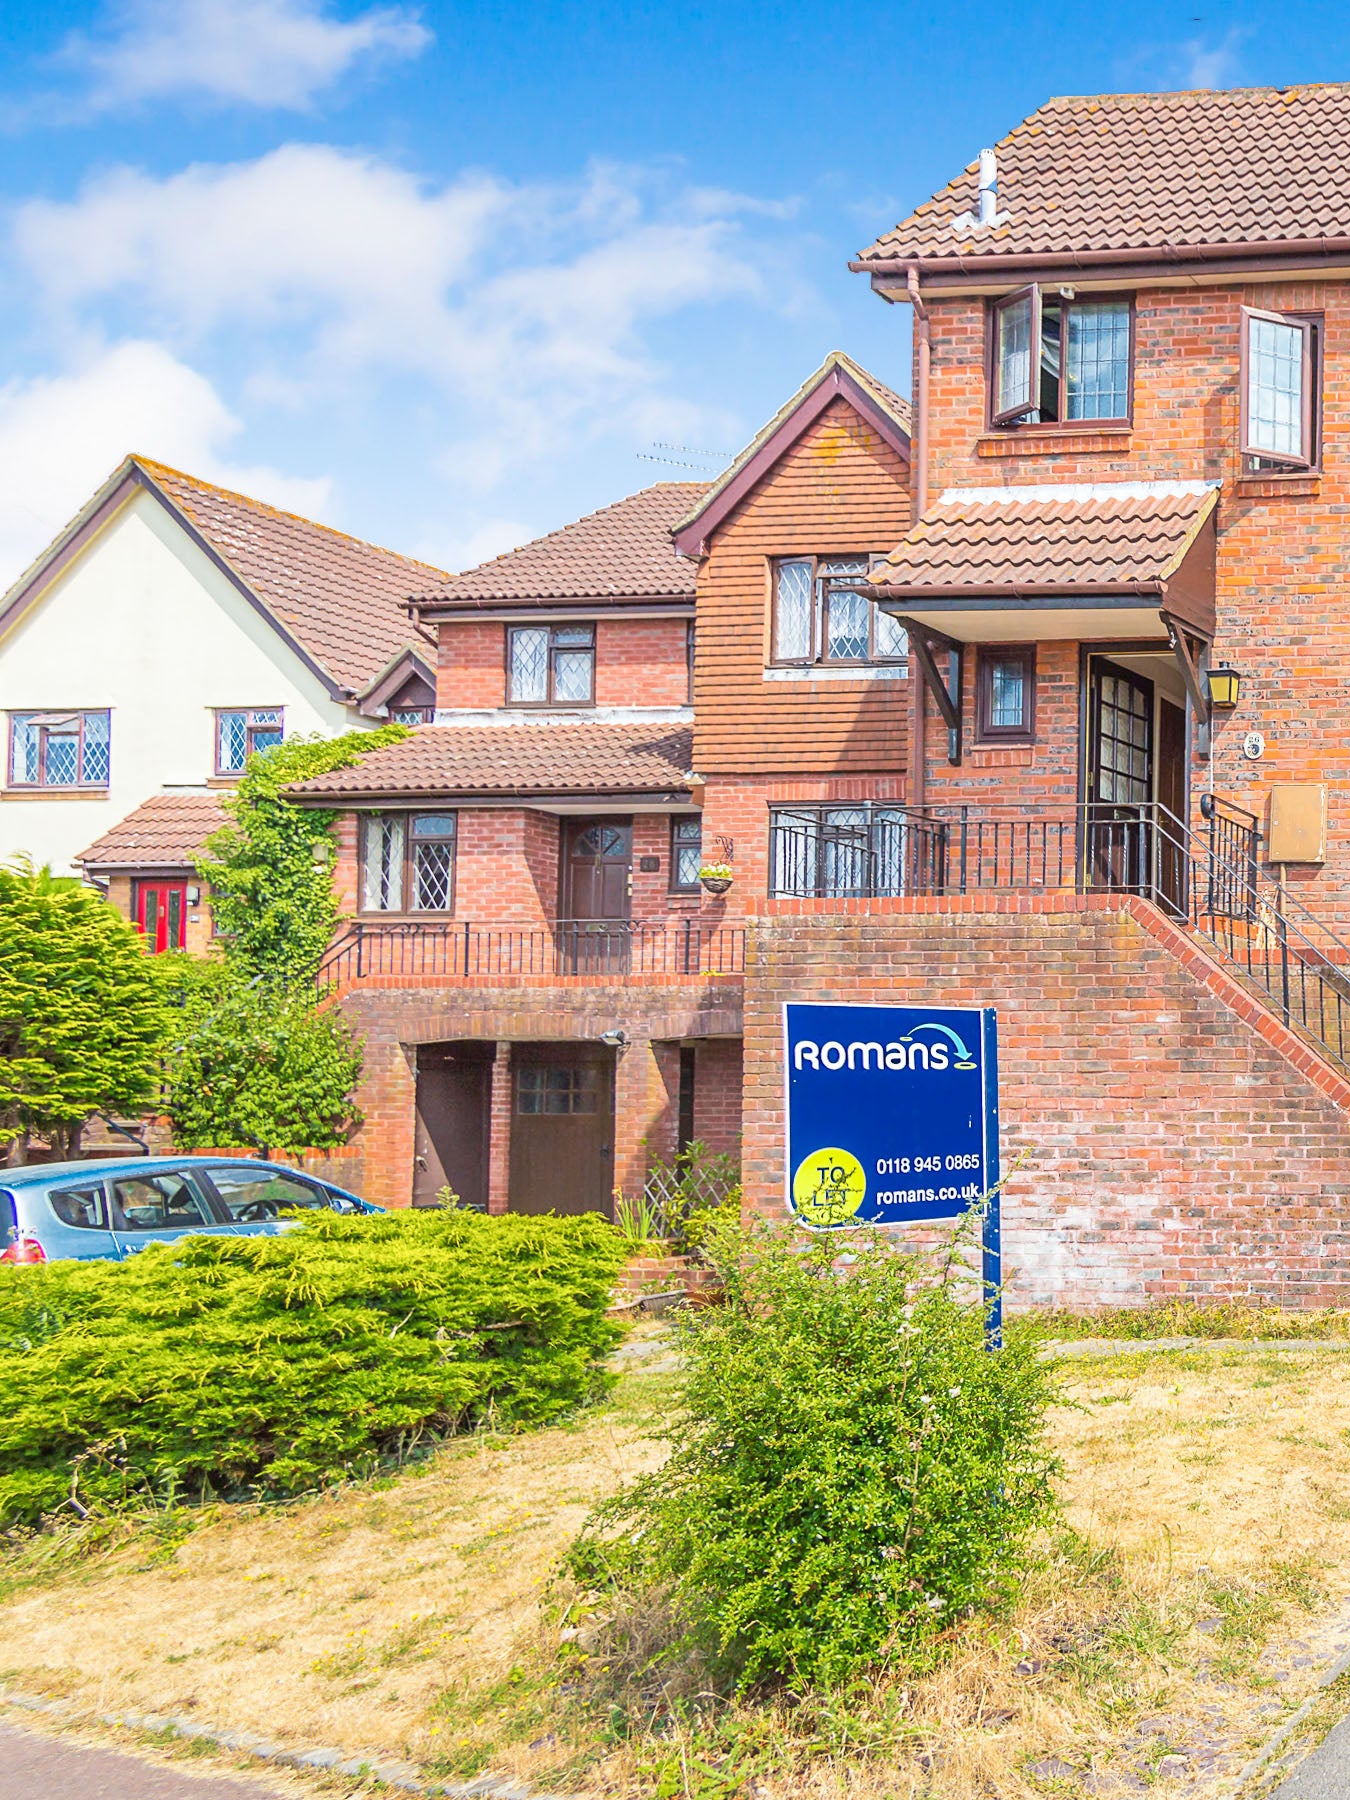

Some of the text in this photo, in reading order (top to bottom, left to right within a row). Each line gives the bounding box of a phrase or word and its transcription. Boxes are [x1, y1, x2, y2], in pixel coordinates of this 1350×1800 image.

[794, 1040, 949, 1070] Romans
[817, 1166, 845, 1184] TO
[876, 1154, 980, 1175] 0118 945 0865
[813, 1188, 849, 1206] LET
[876, 1182, 980, 1206] romans.co.uk
